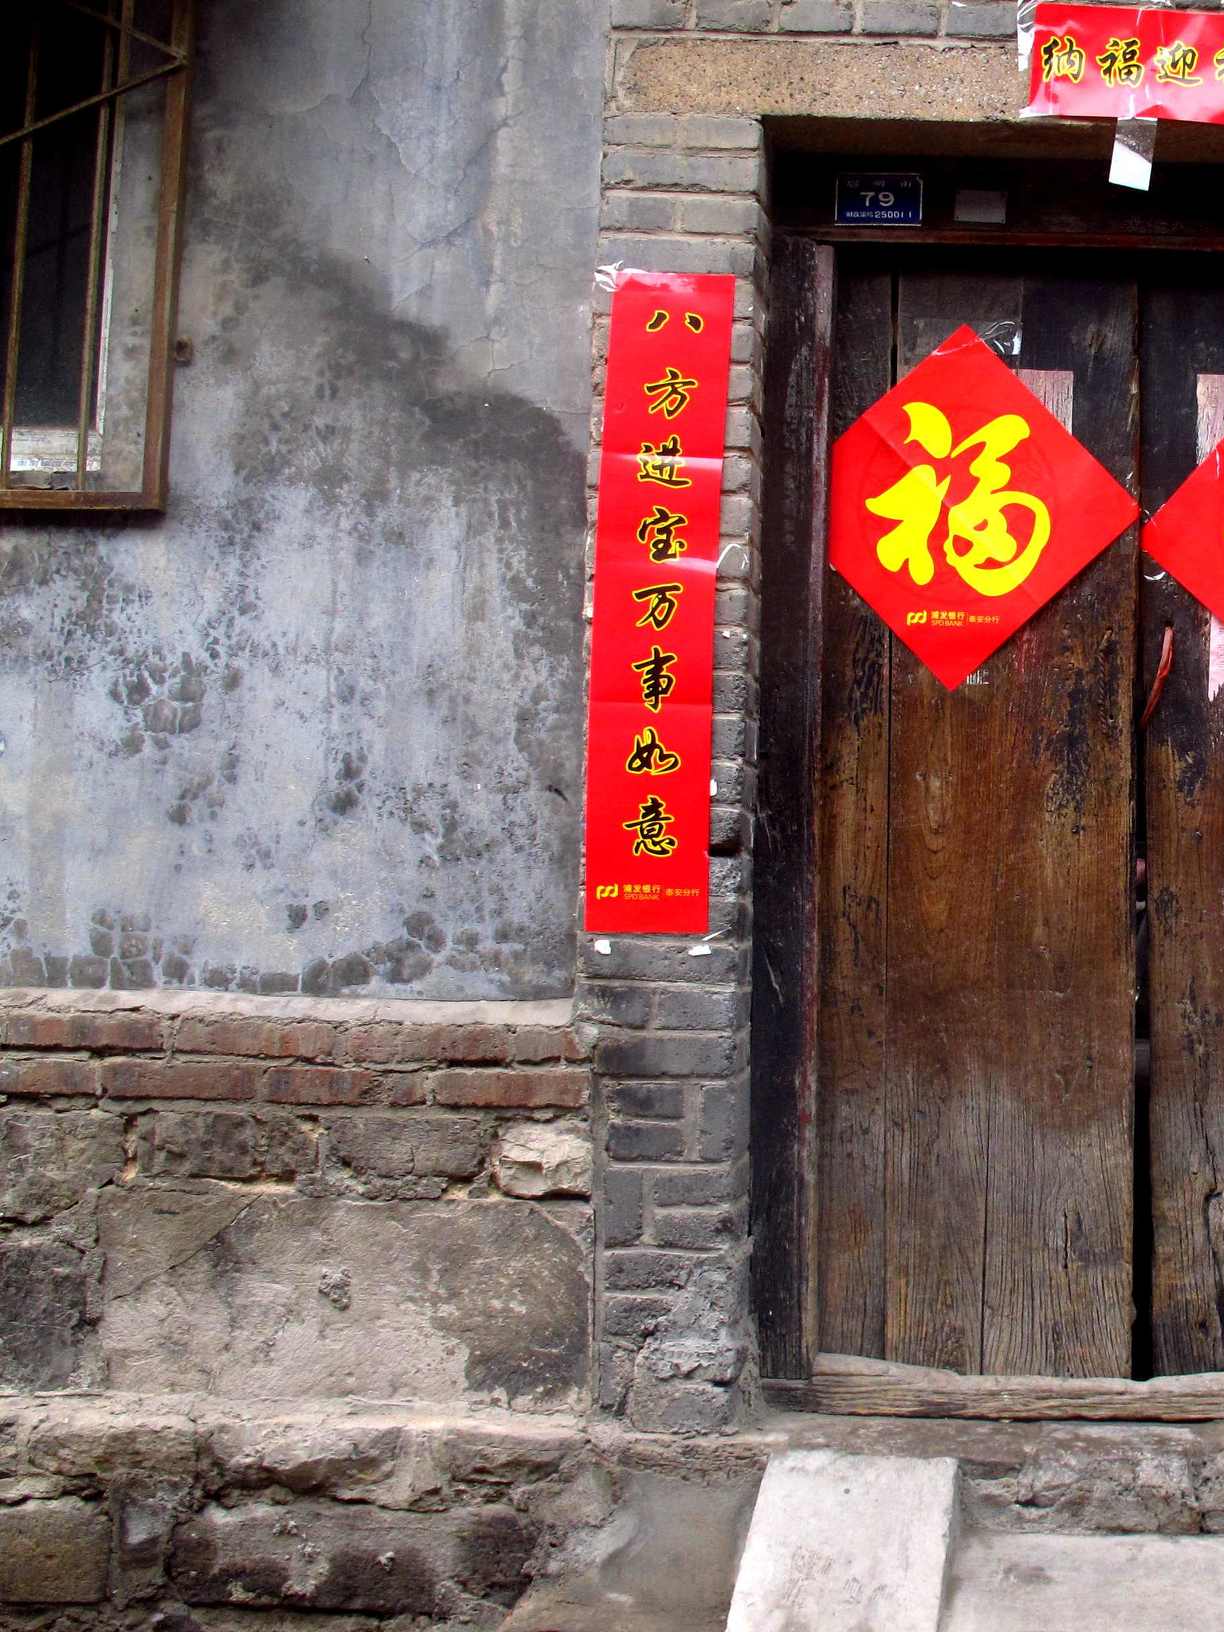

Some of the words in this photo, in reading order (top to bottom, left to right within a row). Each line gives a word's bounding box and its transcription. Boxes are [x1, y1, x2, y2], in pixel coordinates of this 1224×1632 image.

[860, 192, 895, 207] 79
[623, 310, 704, 857] 八方进宝万事如意
[865, 401, 1052, 597] 福
